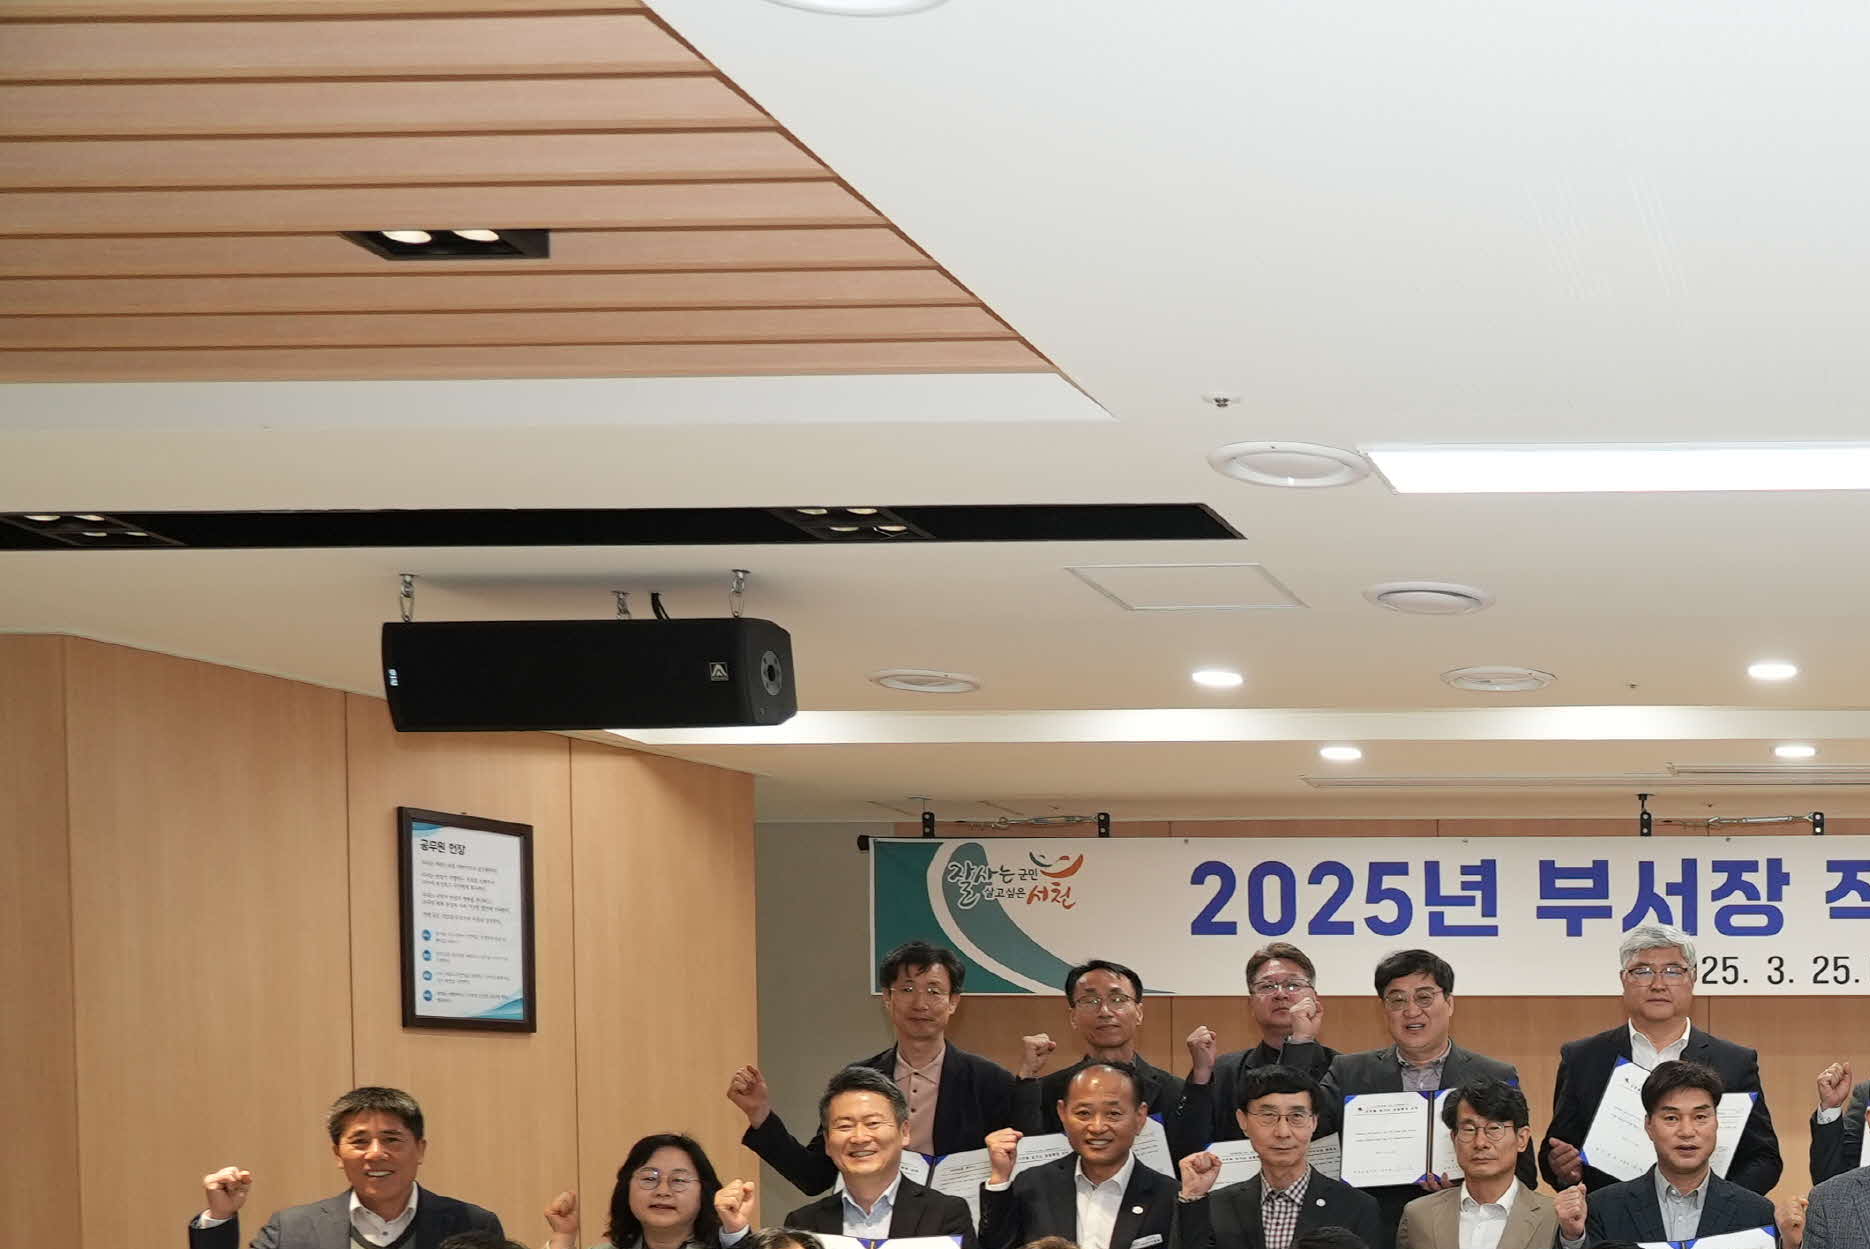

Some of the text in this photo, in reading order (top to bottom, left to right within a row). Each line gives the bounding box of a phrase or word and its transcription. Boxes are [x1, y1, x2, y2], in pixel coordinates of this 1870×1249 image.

[419, 838, 466, 856] 공무원 헌장
[948, 861, 1040, 910] 잘사는 군민
[984, 881, 1077, 910] 살고싶은 서천
[1190, 859, 1499, 937] 2025년
[1536, 857, 1791, 937] 부서장
[1766, 955, 1794, 985] 3.
